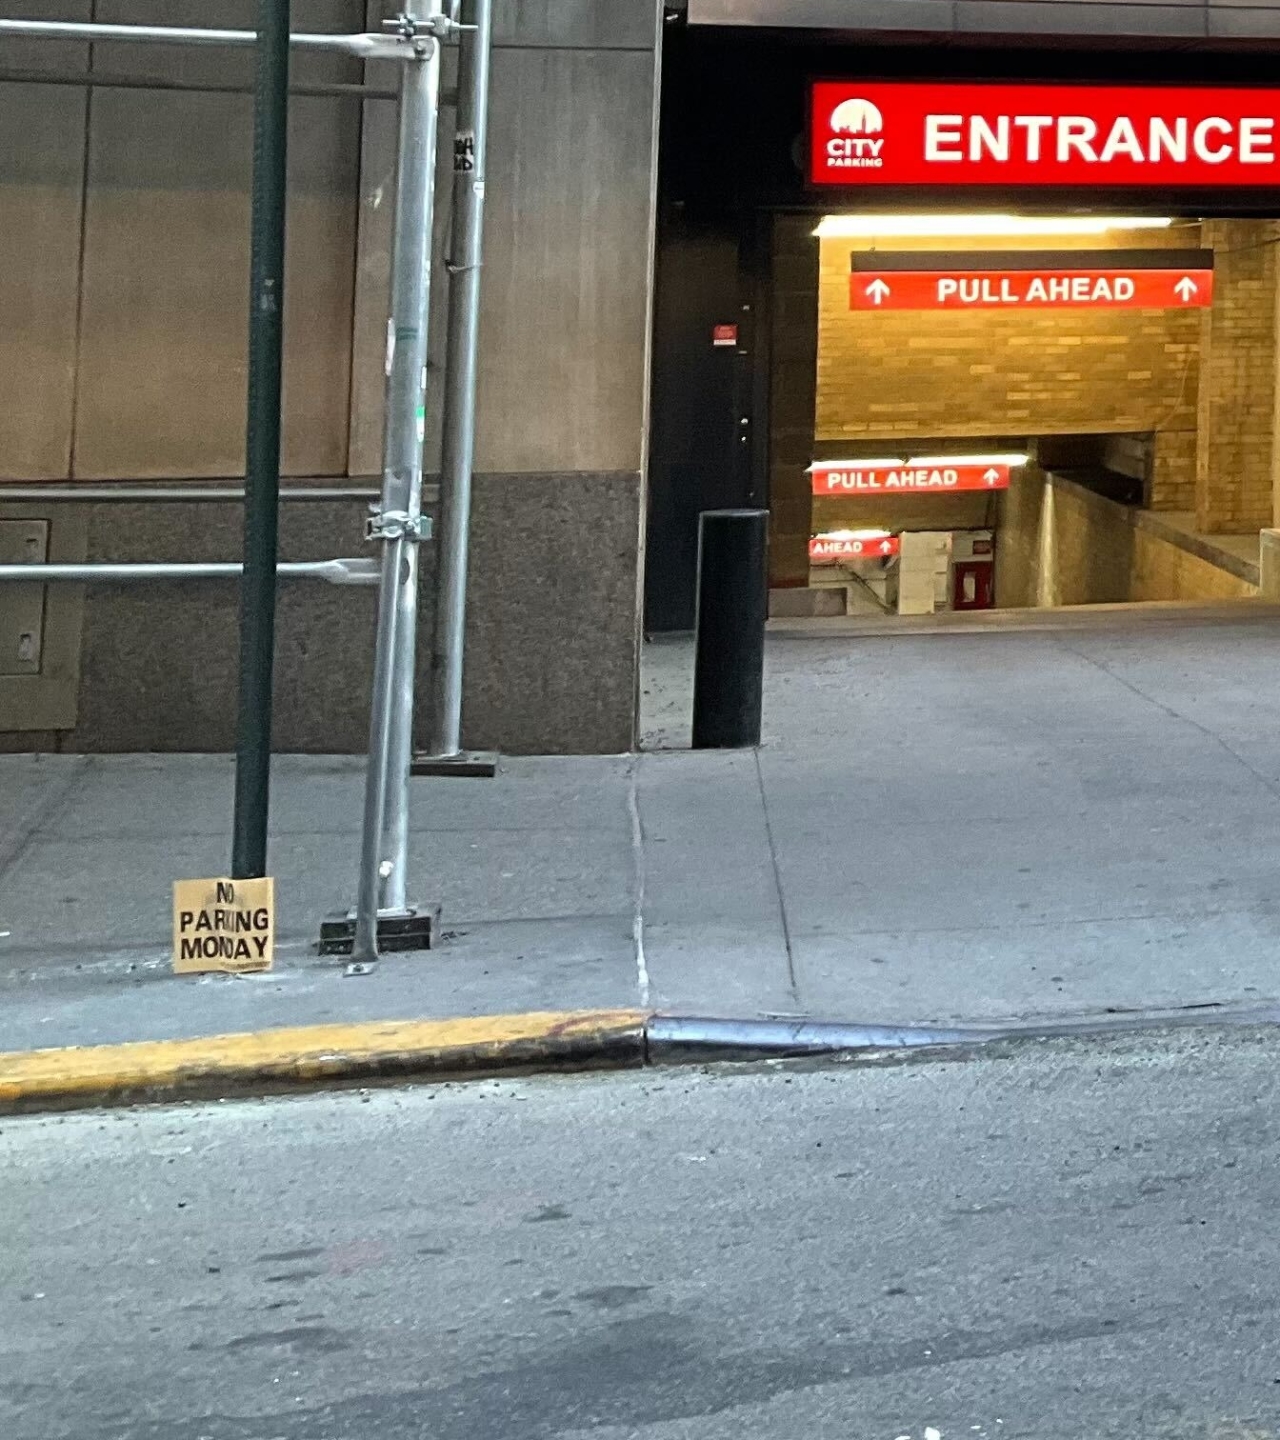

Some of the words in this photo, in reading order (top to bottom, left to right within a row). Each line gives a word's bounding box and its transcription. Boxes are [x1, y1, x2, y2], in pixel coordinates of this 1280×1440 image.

[827, 138, 884, 157] CITY
[924, 114, 1276, 164] ENTRANCE
[827, 157, 883, 168] PARKING
[937, 278, 1019, 302] PULL
[1025, 277, 1135, 301] AHEAD
[827, 472, 881, 489] PULL
[885, 469, 958, 488] AHEAD
[813, 541, 863, 554] AHEAD
